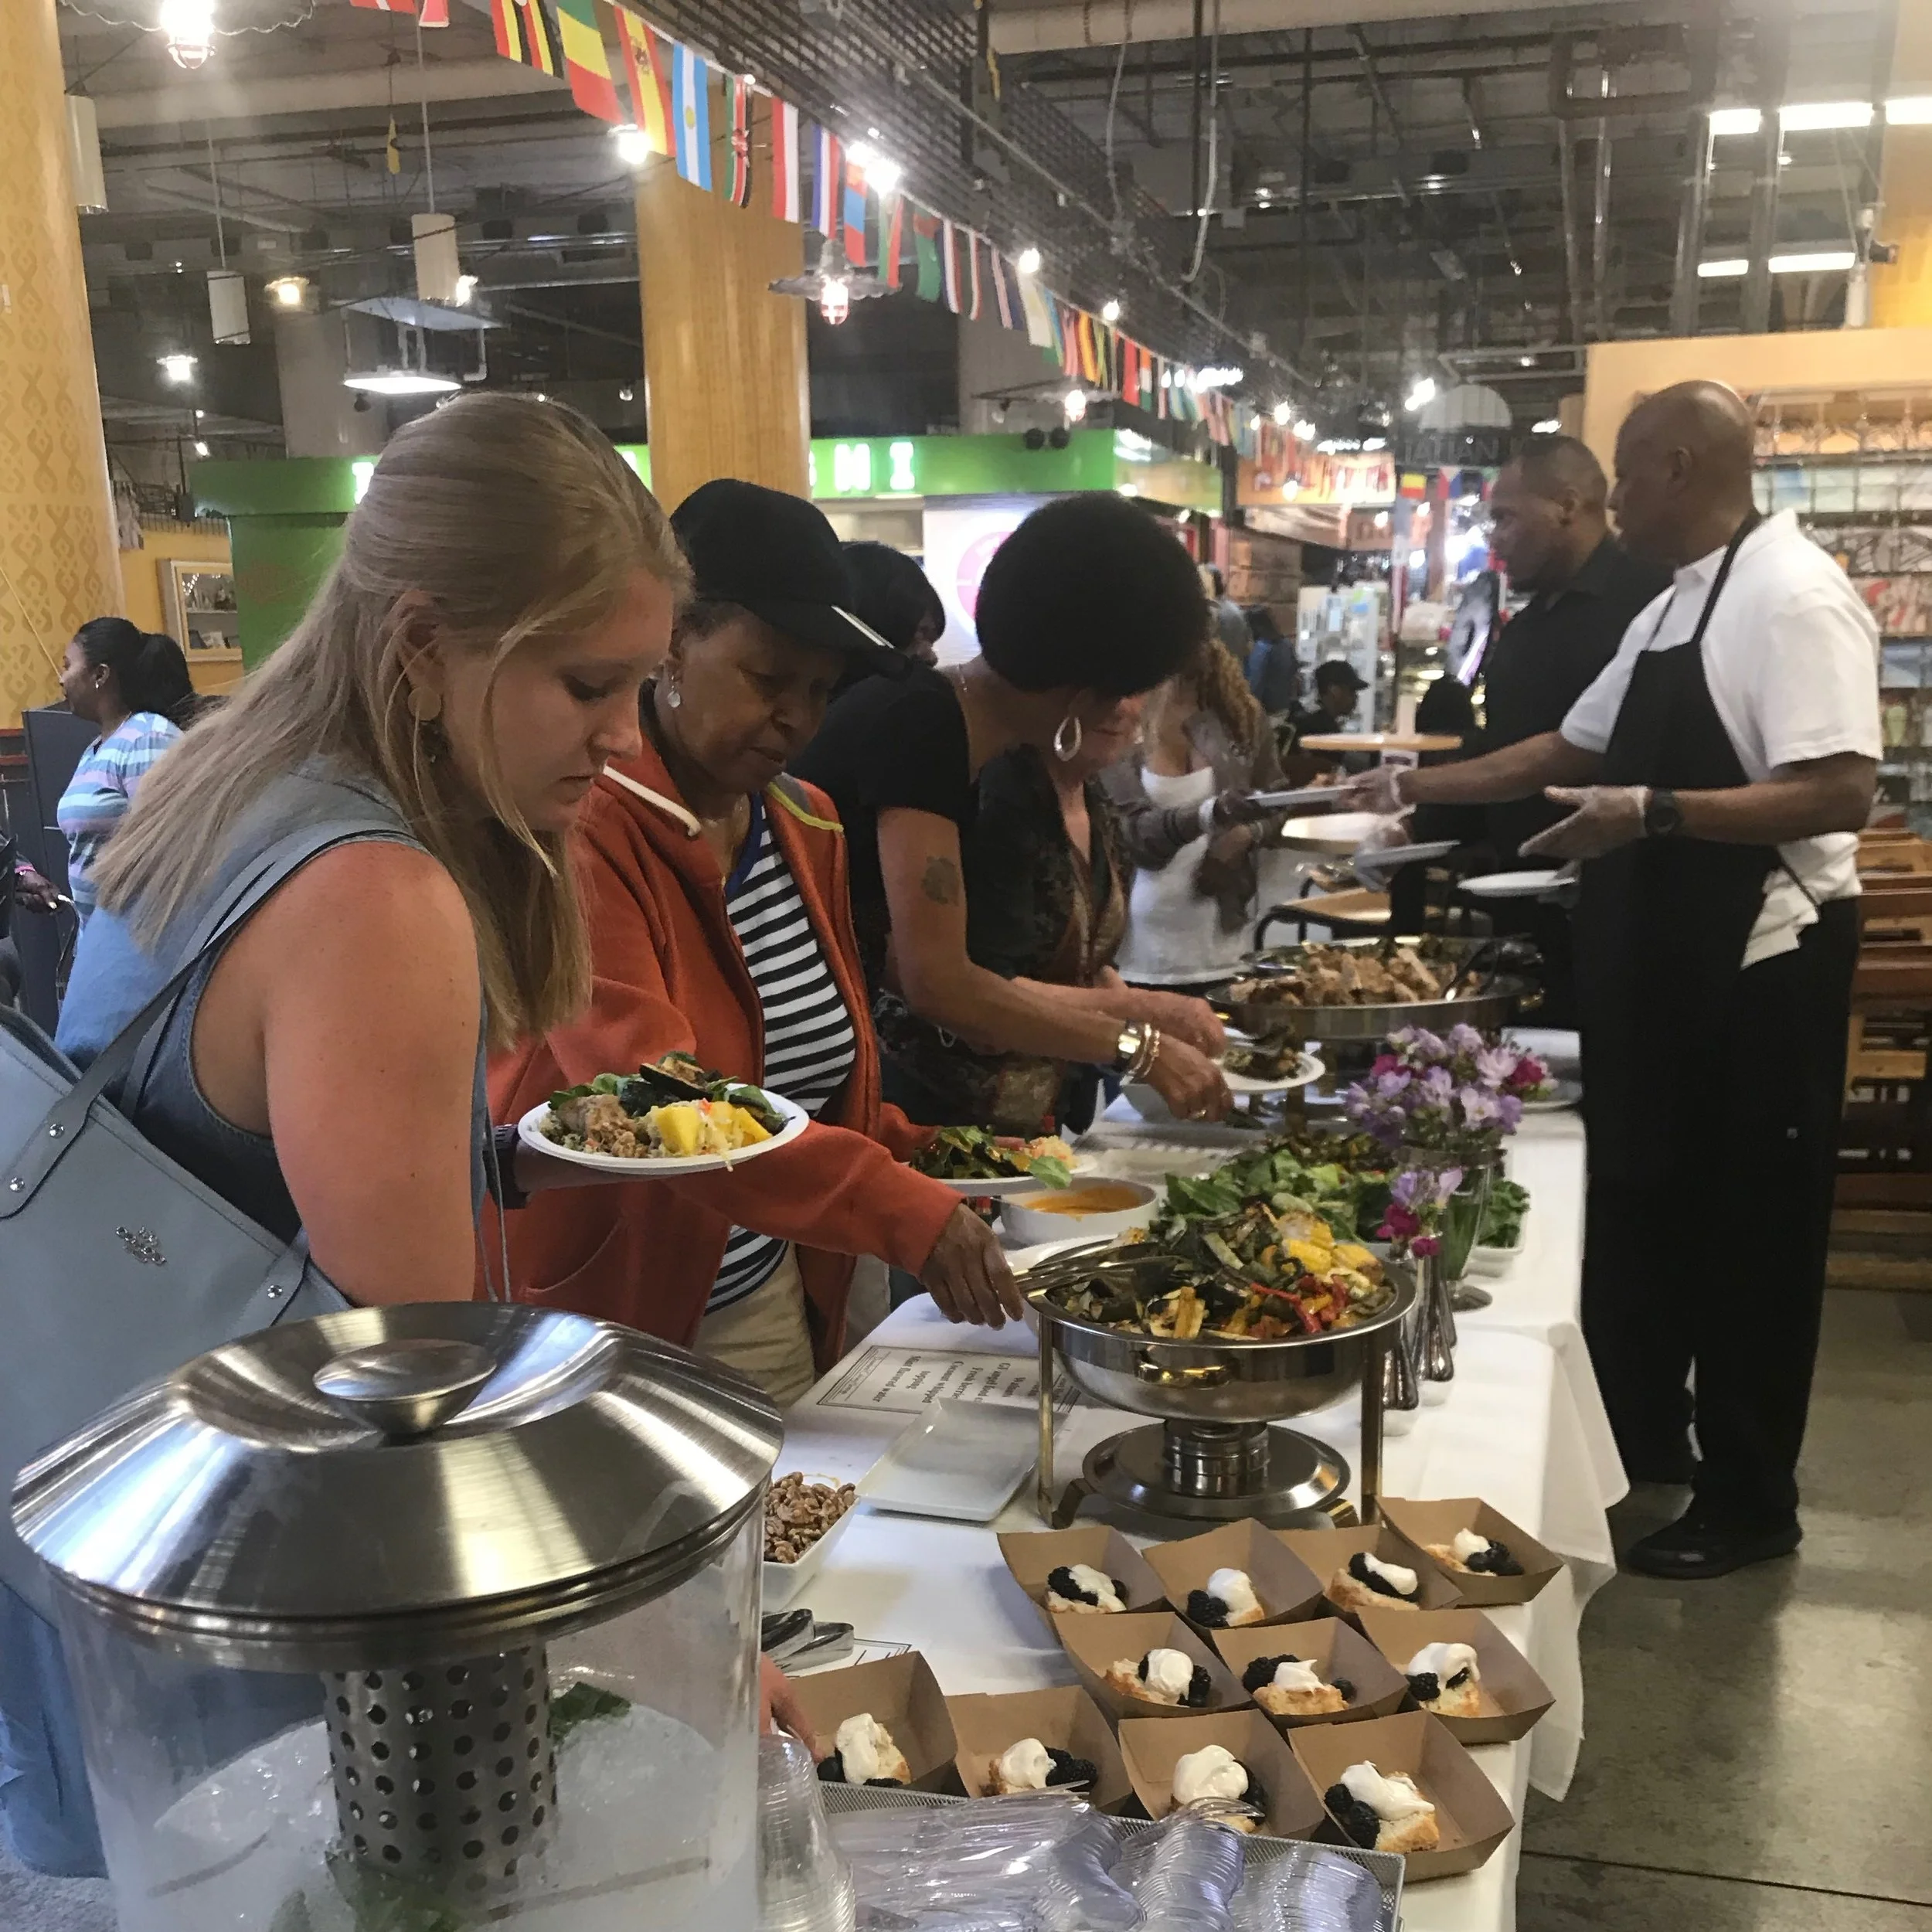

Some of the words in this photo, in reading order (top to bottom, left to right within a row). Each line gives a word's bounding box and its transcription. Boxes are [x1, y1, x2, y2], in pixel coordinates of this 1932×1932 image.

[903, 1355, 921, 1366] Mint
[885, 1367, 911, 1387] flavored
[906, 1370, 931, 1389] topping
[940, 1361, 964, 1382] Coconut
[964, 1367, 984, 1382] Fresh
[872, 1388, 891, 1403] water
[921, 1382, 946, 1403] whipped
[951, 1382, 973, 1400] berrie
[978, 1385, 996, 1396] food
